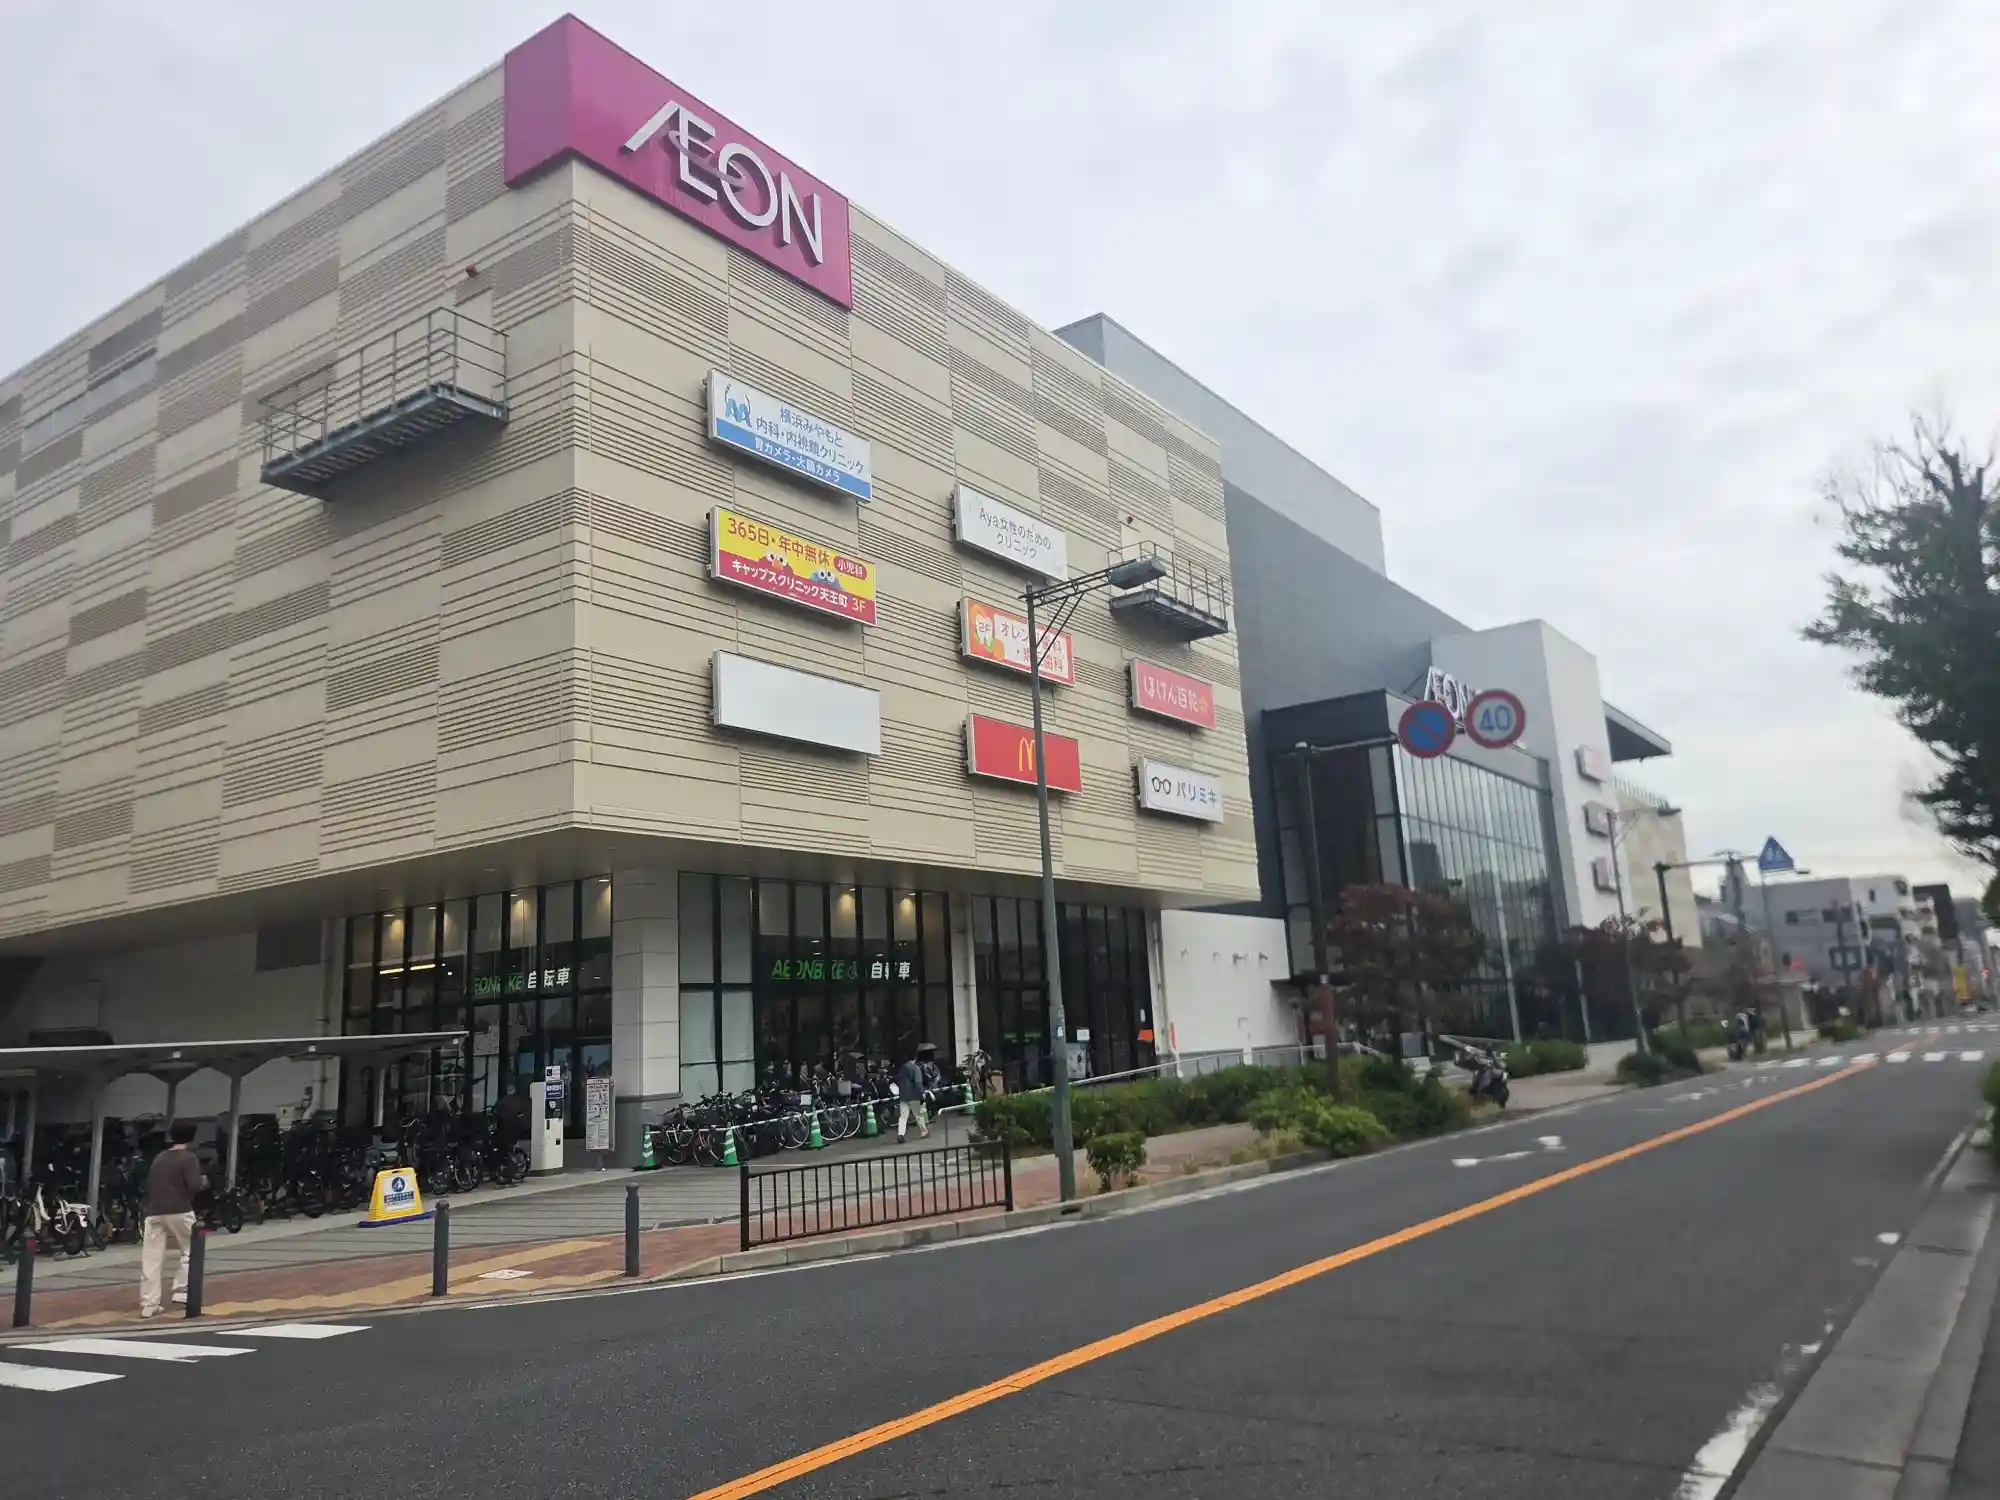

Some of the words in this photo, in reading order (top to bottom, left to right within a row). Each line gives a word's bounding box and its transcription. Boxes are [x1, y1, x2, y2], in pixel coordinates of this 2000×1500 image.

[780, 406, 844, 448] 横浜みやもと
[727, 517, 830, 567] 365日・年中無休
[996, 532, 1037, 559] クリニック
[837, 559, 864, 577] 小児科
[851, 597, 867, 613] 3F
[1480, 704, 1510, 732] 40
[1176, 780, 1218, 808] パリミキ
